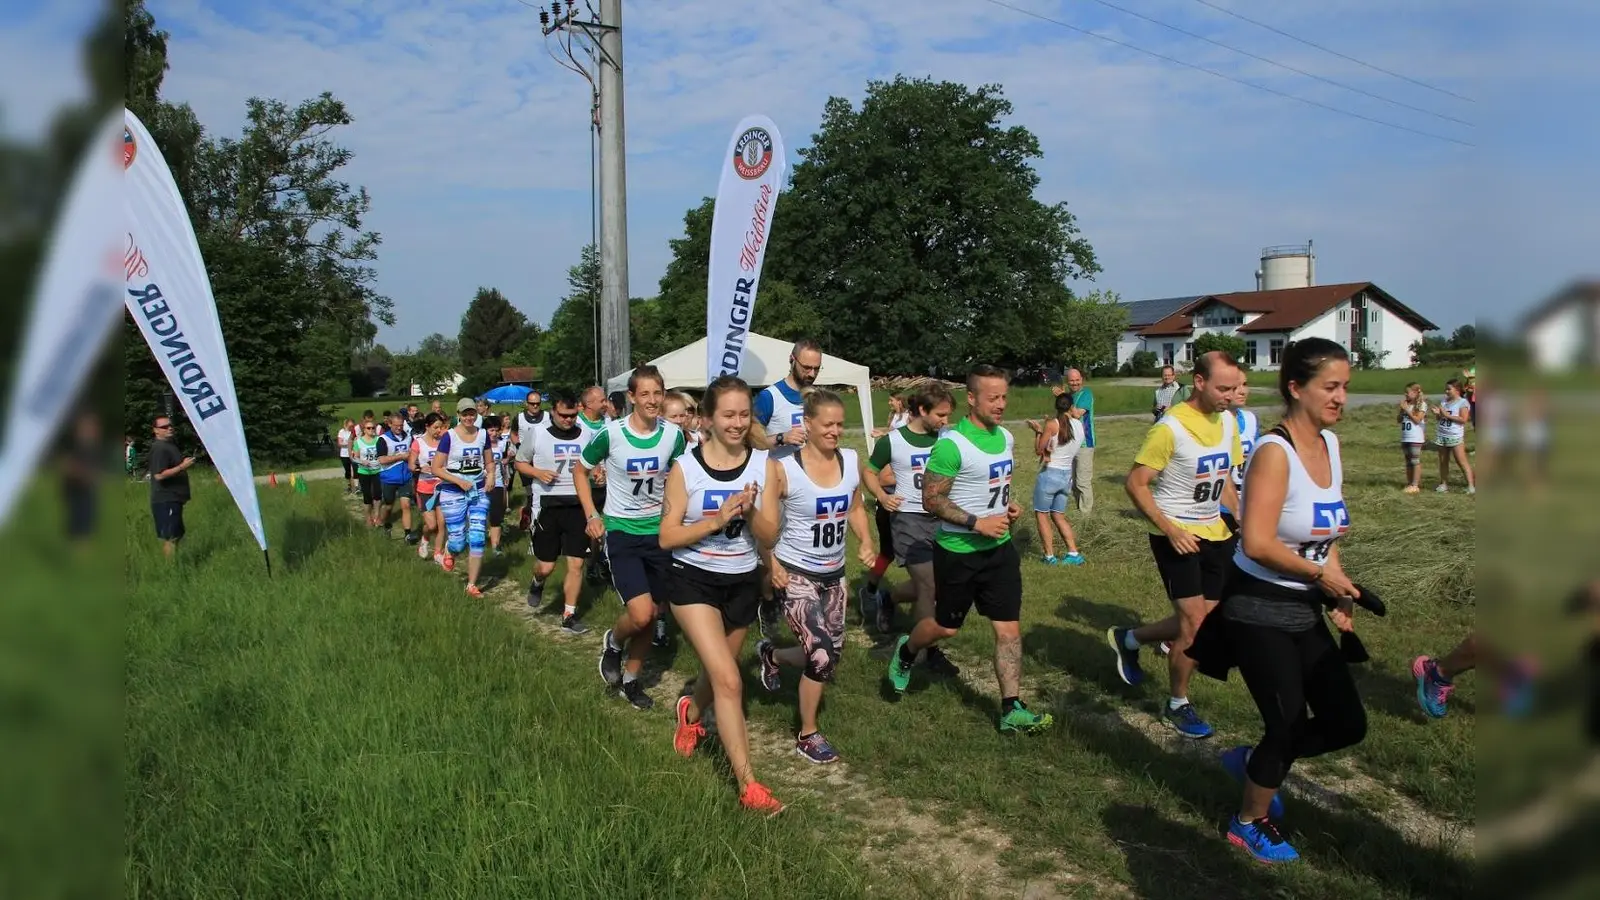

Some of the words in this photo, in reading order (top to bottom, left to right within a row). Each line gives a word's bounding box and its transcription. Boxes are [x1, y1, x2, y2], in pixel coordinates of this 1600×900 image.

[736, 131, 770, 153] ERDINGER
[718, 277, 755, 376] RDINGER
[630, 477, 655, 496] 71
[987, 484, 1010, 509] 78
[1193, 479, 1225, 503] 60
[810, 520, 846, 549] 185
